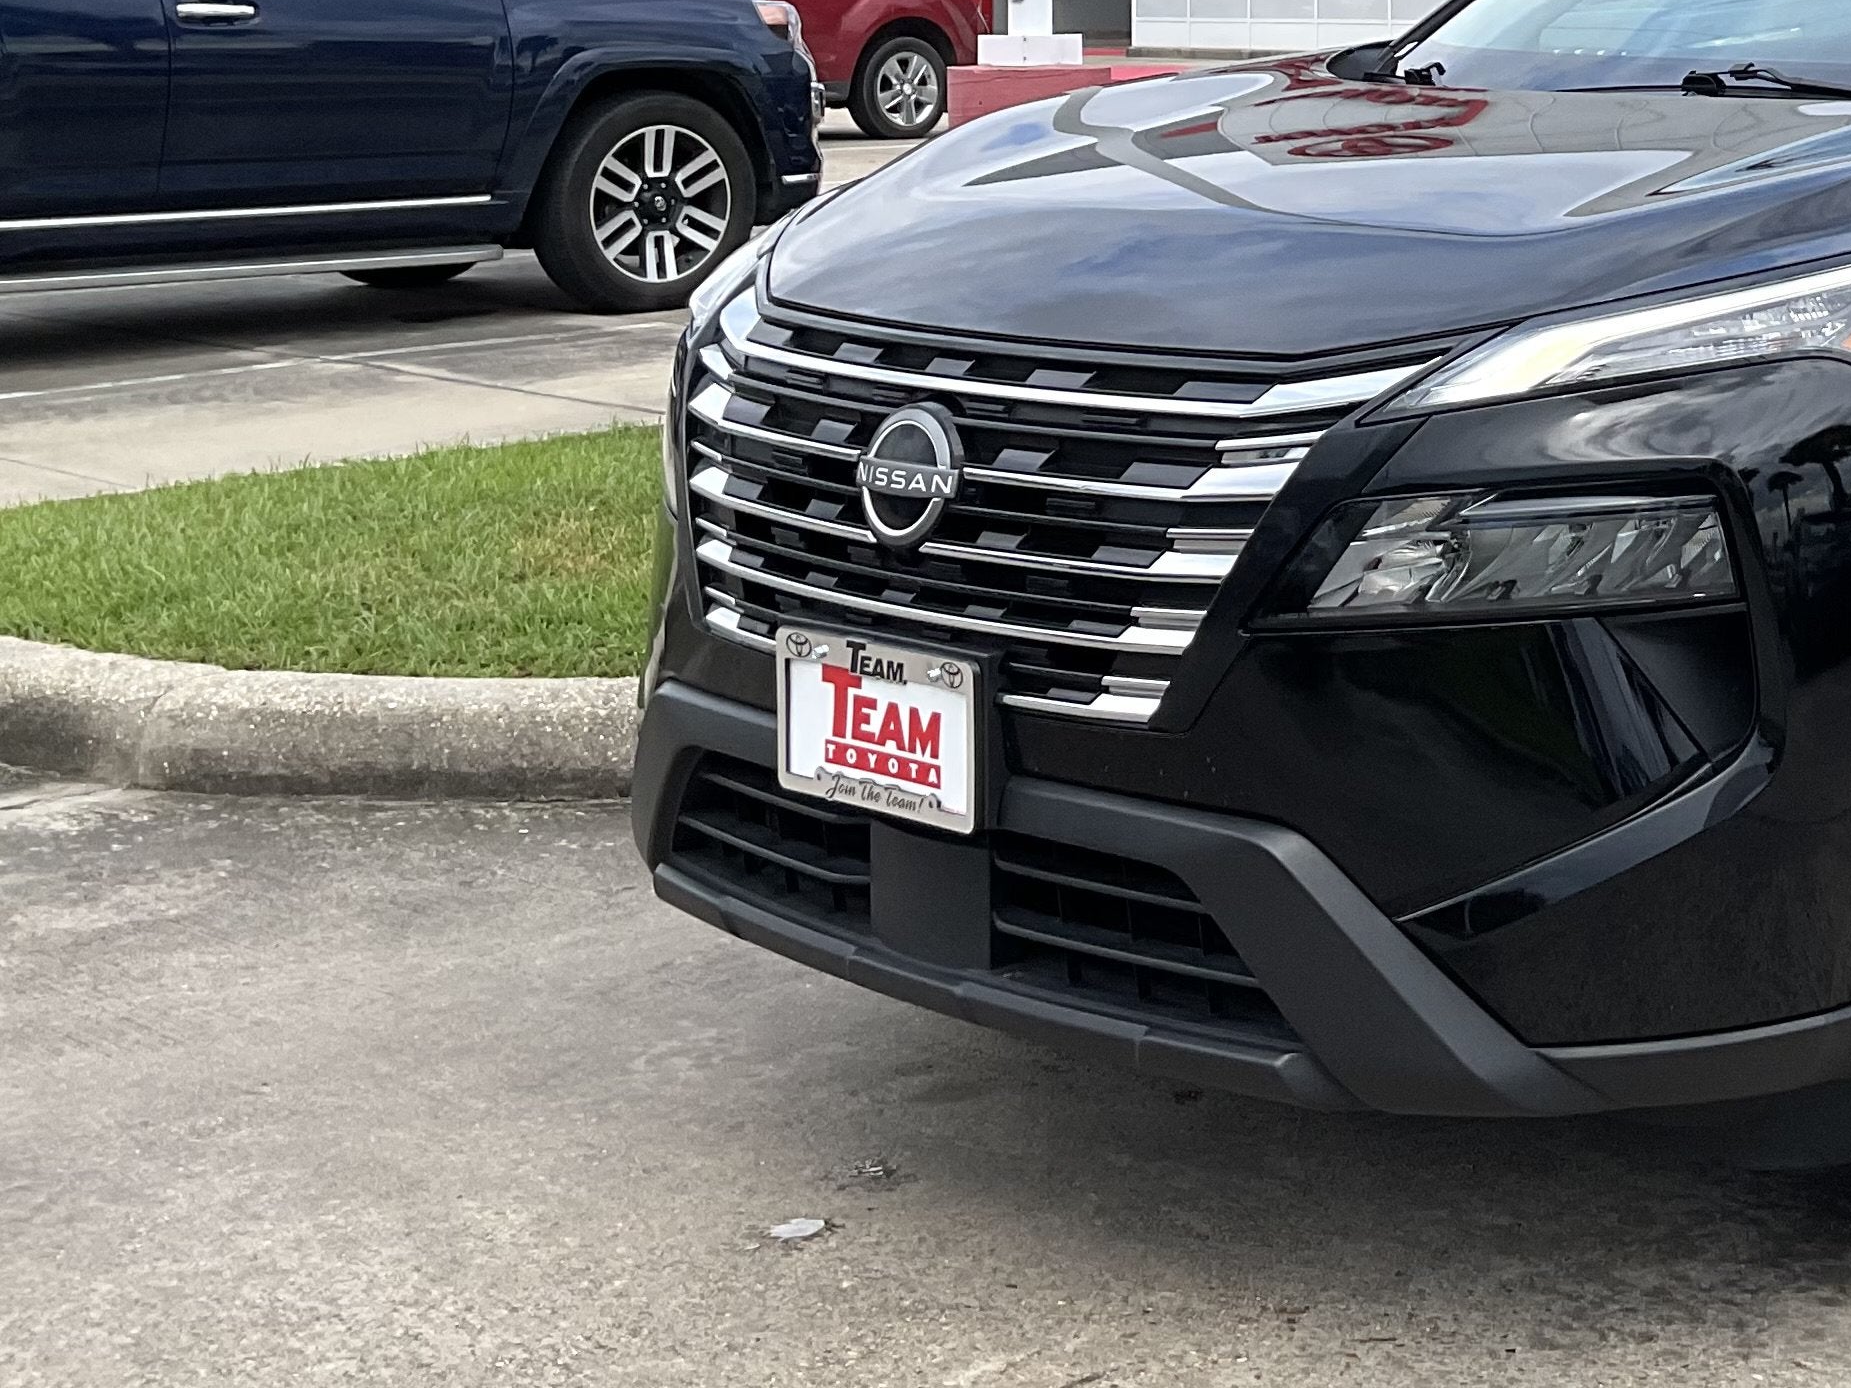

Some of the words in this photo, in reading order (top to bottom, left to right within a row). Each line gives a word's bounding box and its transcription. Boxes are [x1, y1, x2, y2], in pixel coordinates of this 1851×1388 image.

[857, 461, 953, 494] NISSAN
[822, 663, 942, 761] TEAM
[826, 744, 939, 784] TOYOTA
[825, 773, 856, 799] Join
[885, 785, 924, 813] Team!
